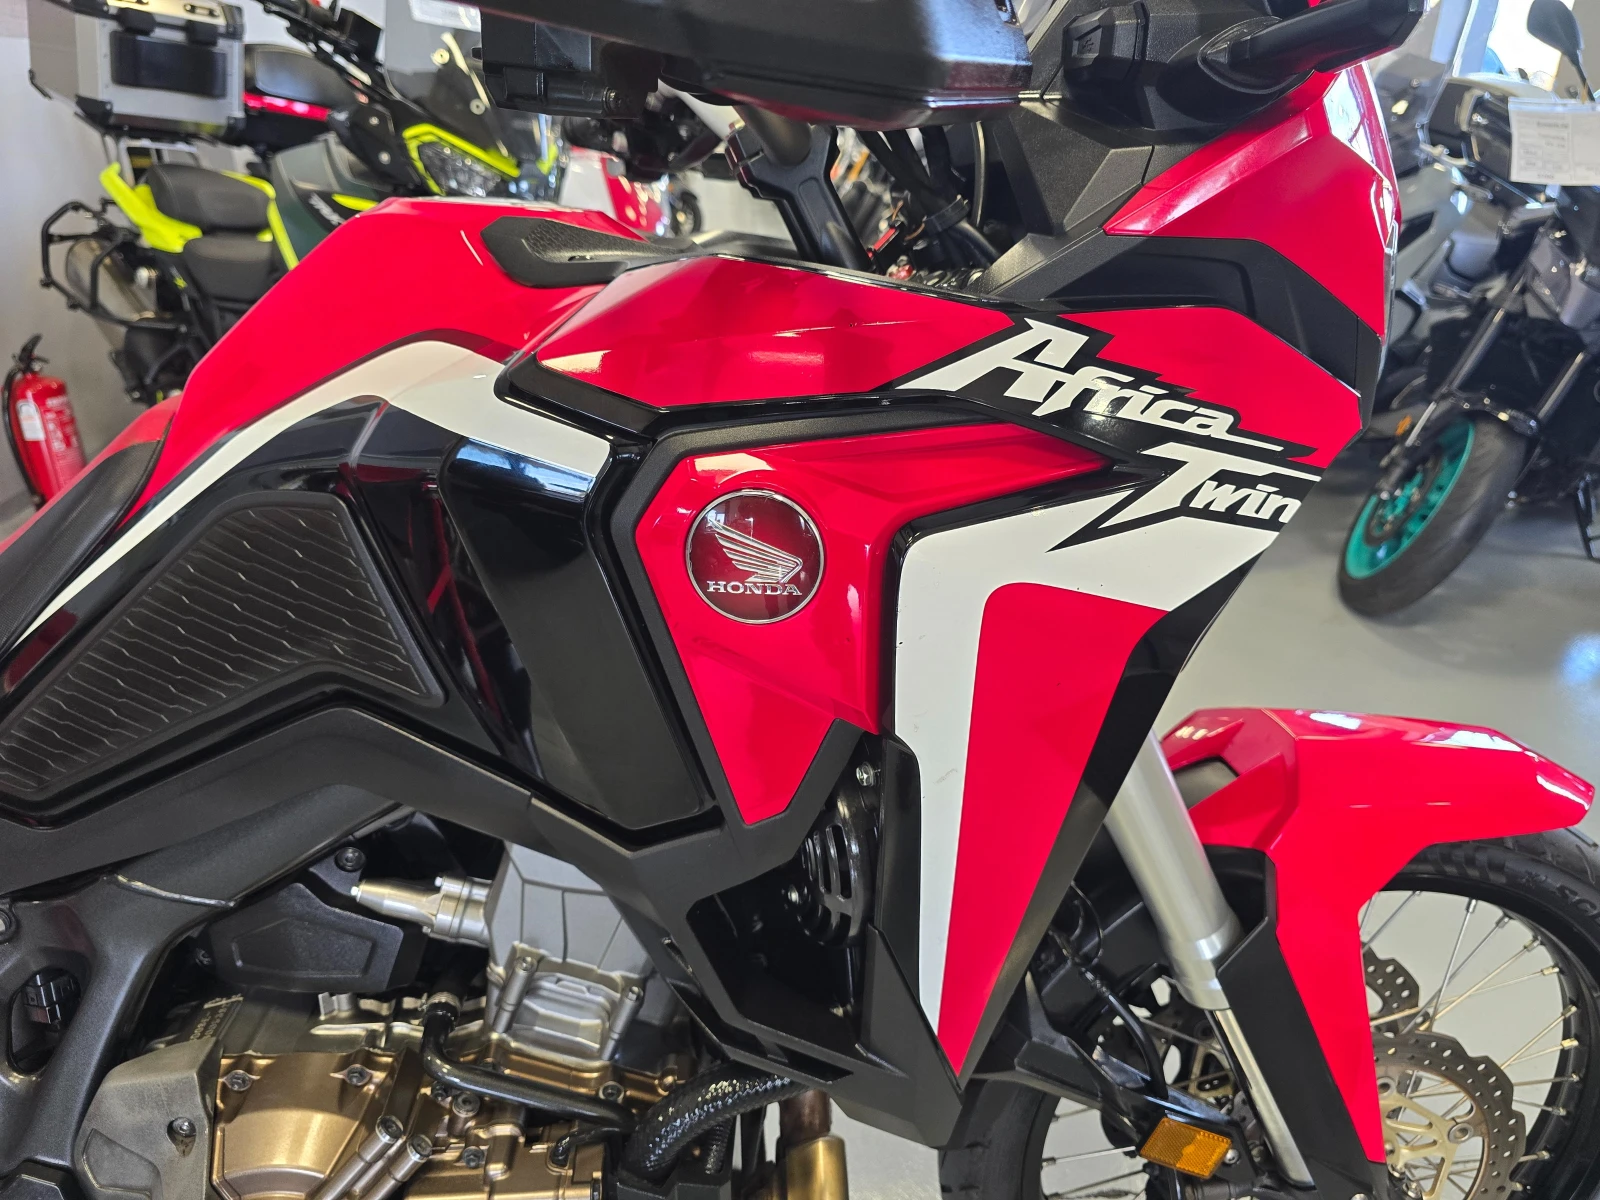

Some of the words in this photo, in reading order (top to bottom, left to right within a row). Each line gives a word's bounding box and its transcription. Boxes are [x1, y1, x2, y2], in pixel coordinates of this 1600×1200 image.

[895, 317, 1284, 451] Africa
[1098, 441, 1322, 529] Twin
[706, 580, 802, 596] HONDA
